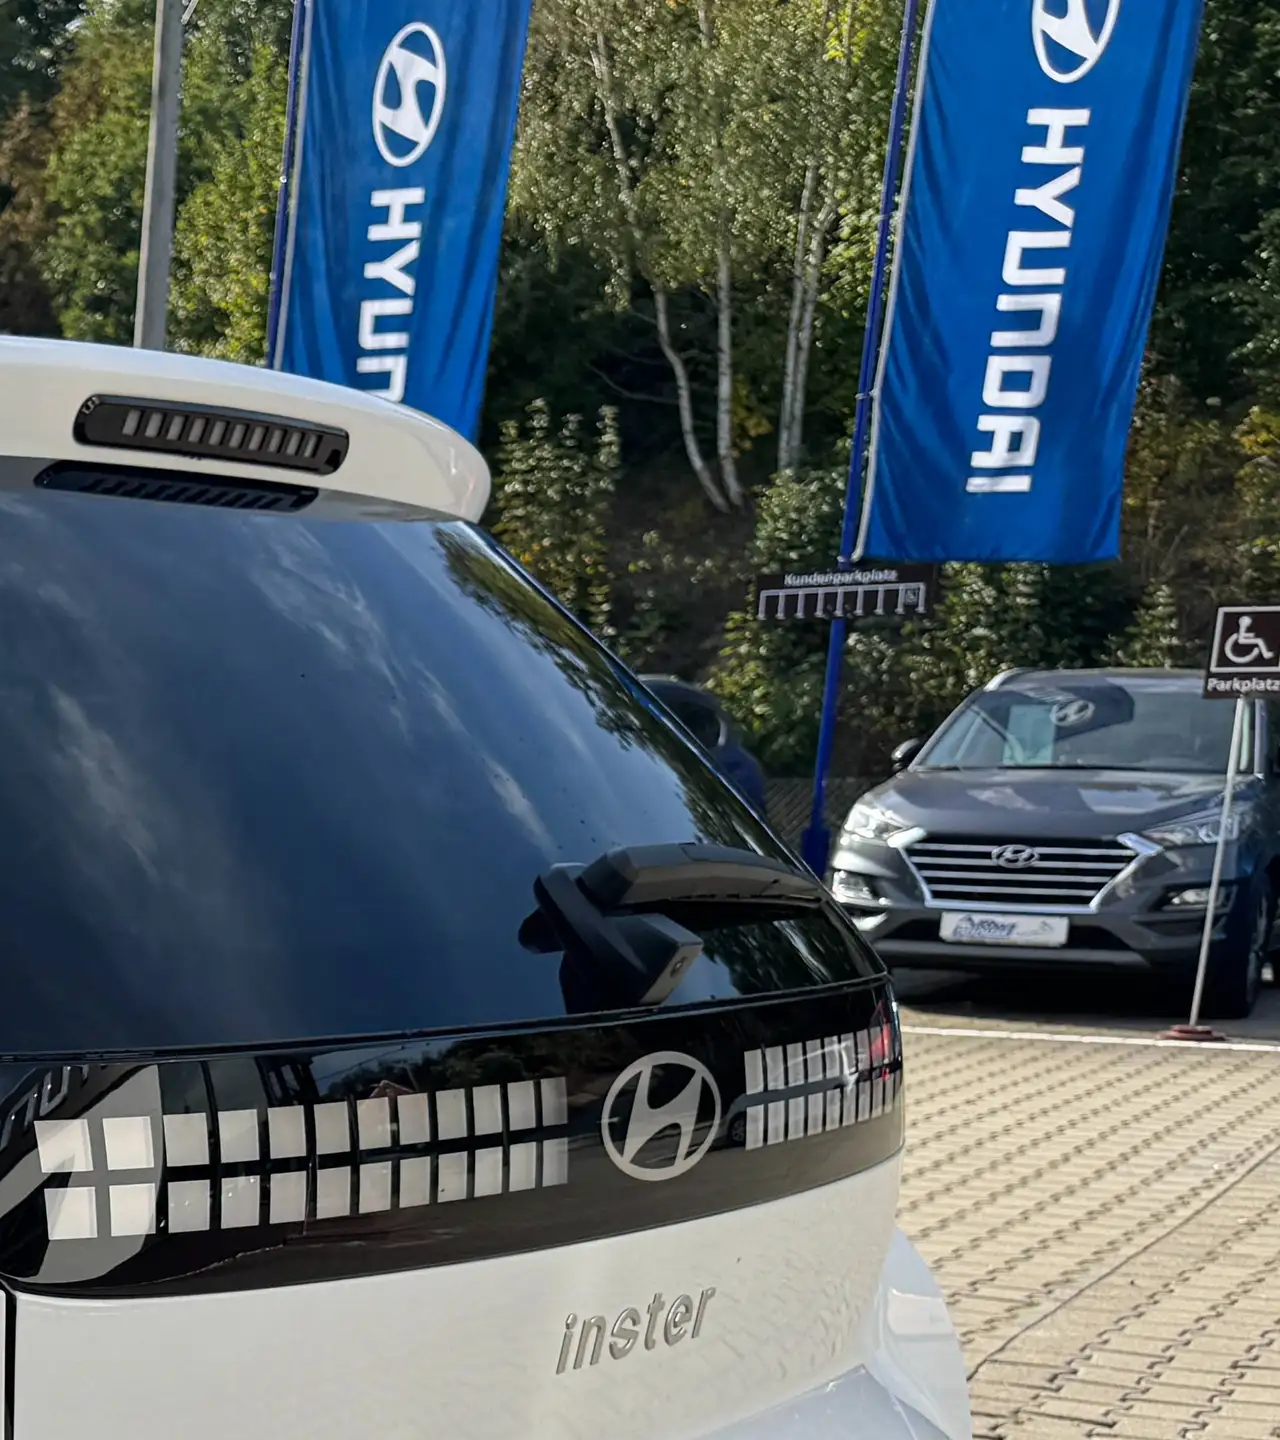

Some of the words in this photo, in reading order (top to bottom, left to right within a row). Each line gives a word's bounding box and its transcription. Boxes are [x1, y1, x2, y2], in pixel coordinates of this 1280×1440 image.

[965, 107, 1092, 494] HYUNDAI
[784, 568, 899, 587] Kundenparkplatz
[1207, 677, 1280, 694] Parkplatz
[555, 1286, 717, 1375] inster
